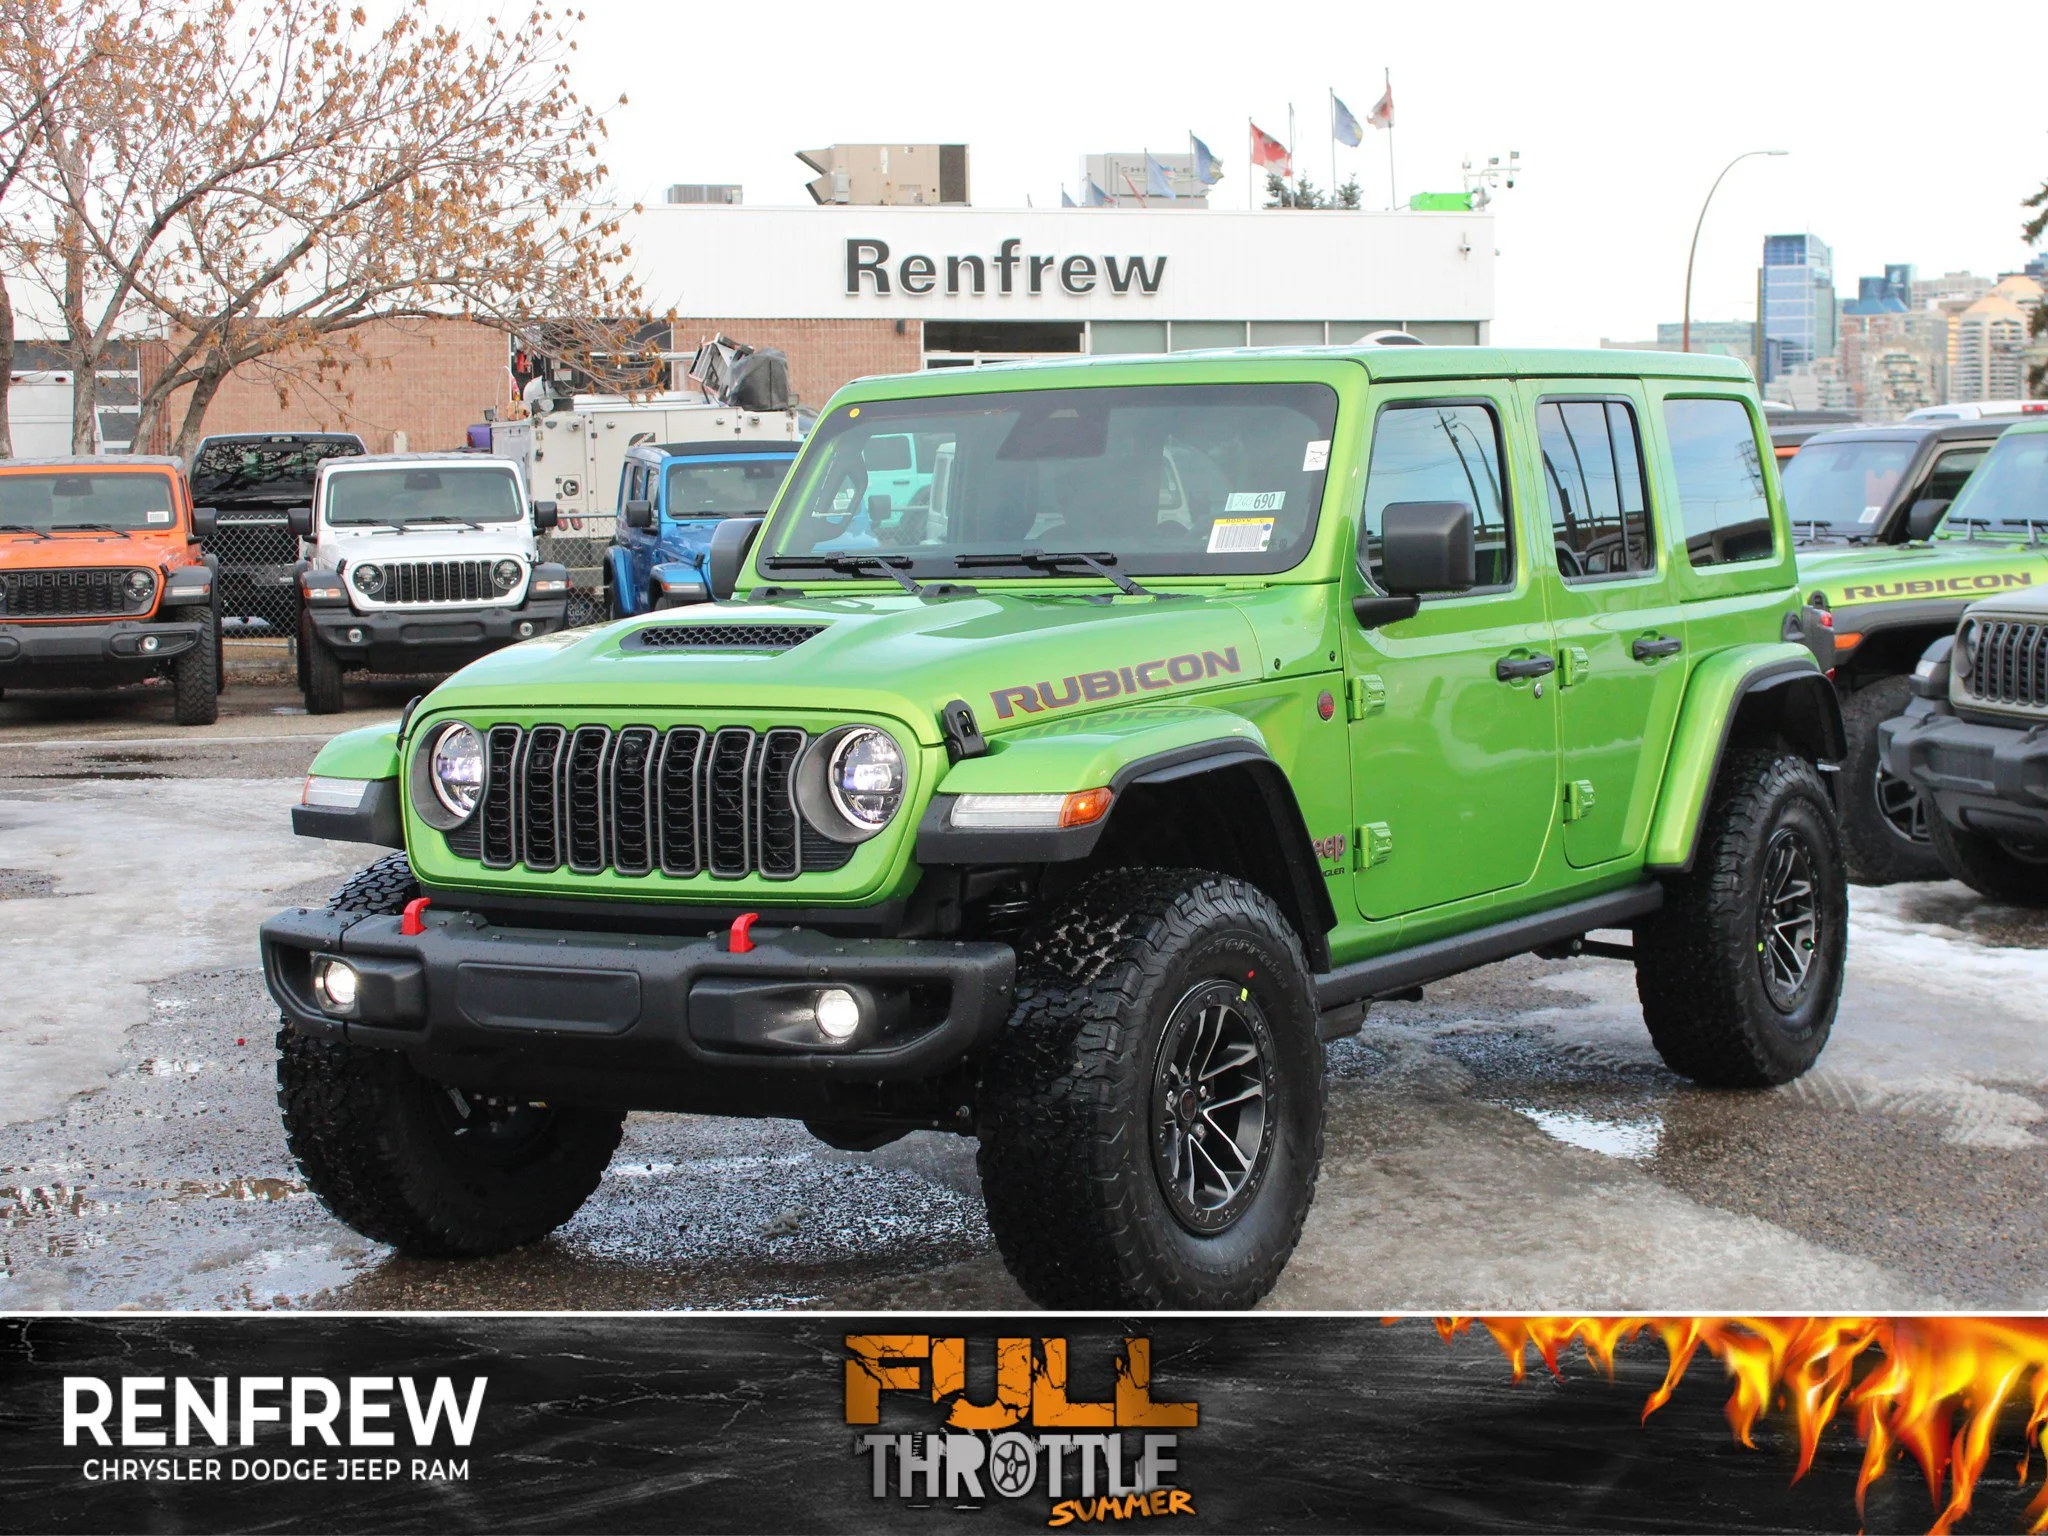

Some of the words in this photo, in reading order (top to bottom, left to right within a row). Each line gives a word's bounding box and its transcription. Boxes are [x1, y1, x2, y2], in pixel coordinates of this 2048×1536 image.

[845, 238, 1168, 296] Renfrew
[1843, 572, 2032, 600] RUBICON
[989, 646, 1241, 719] RUBICON
[1312, 834, 1346, 862] eep
